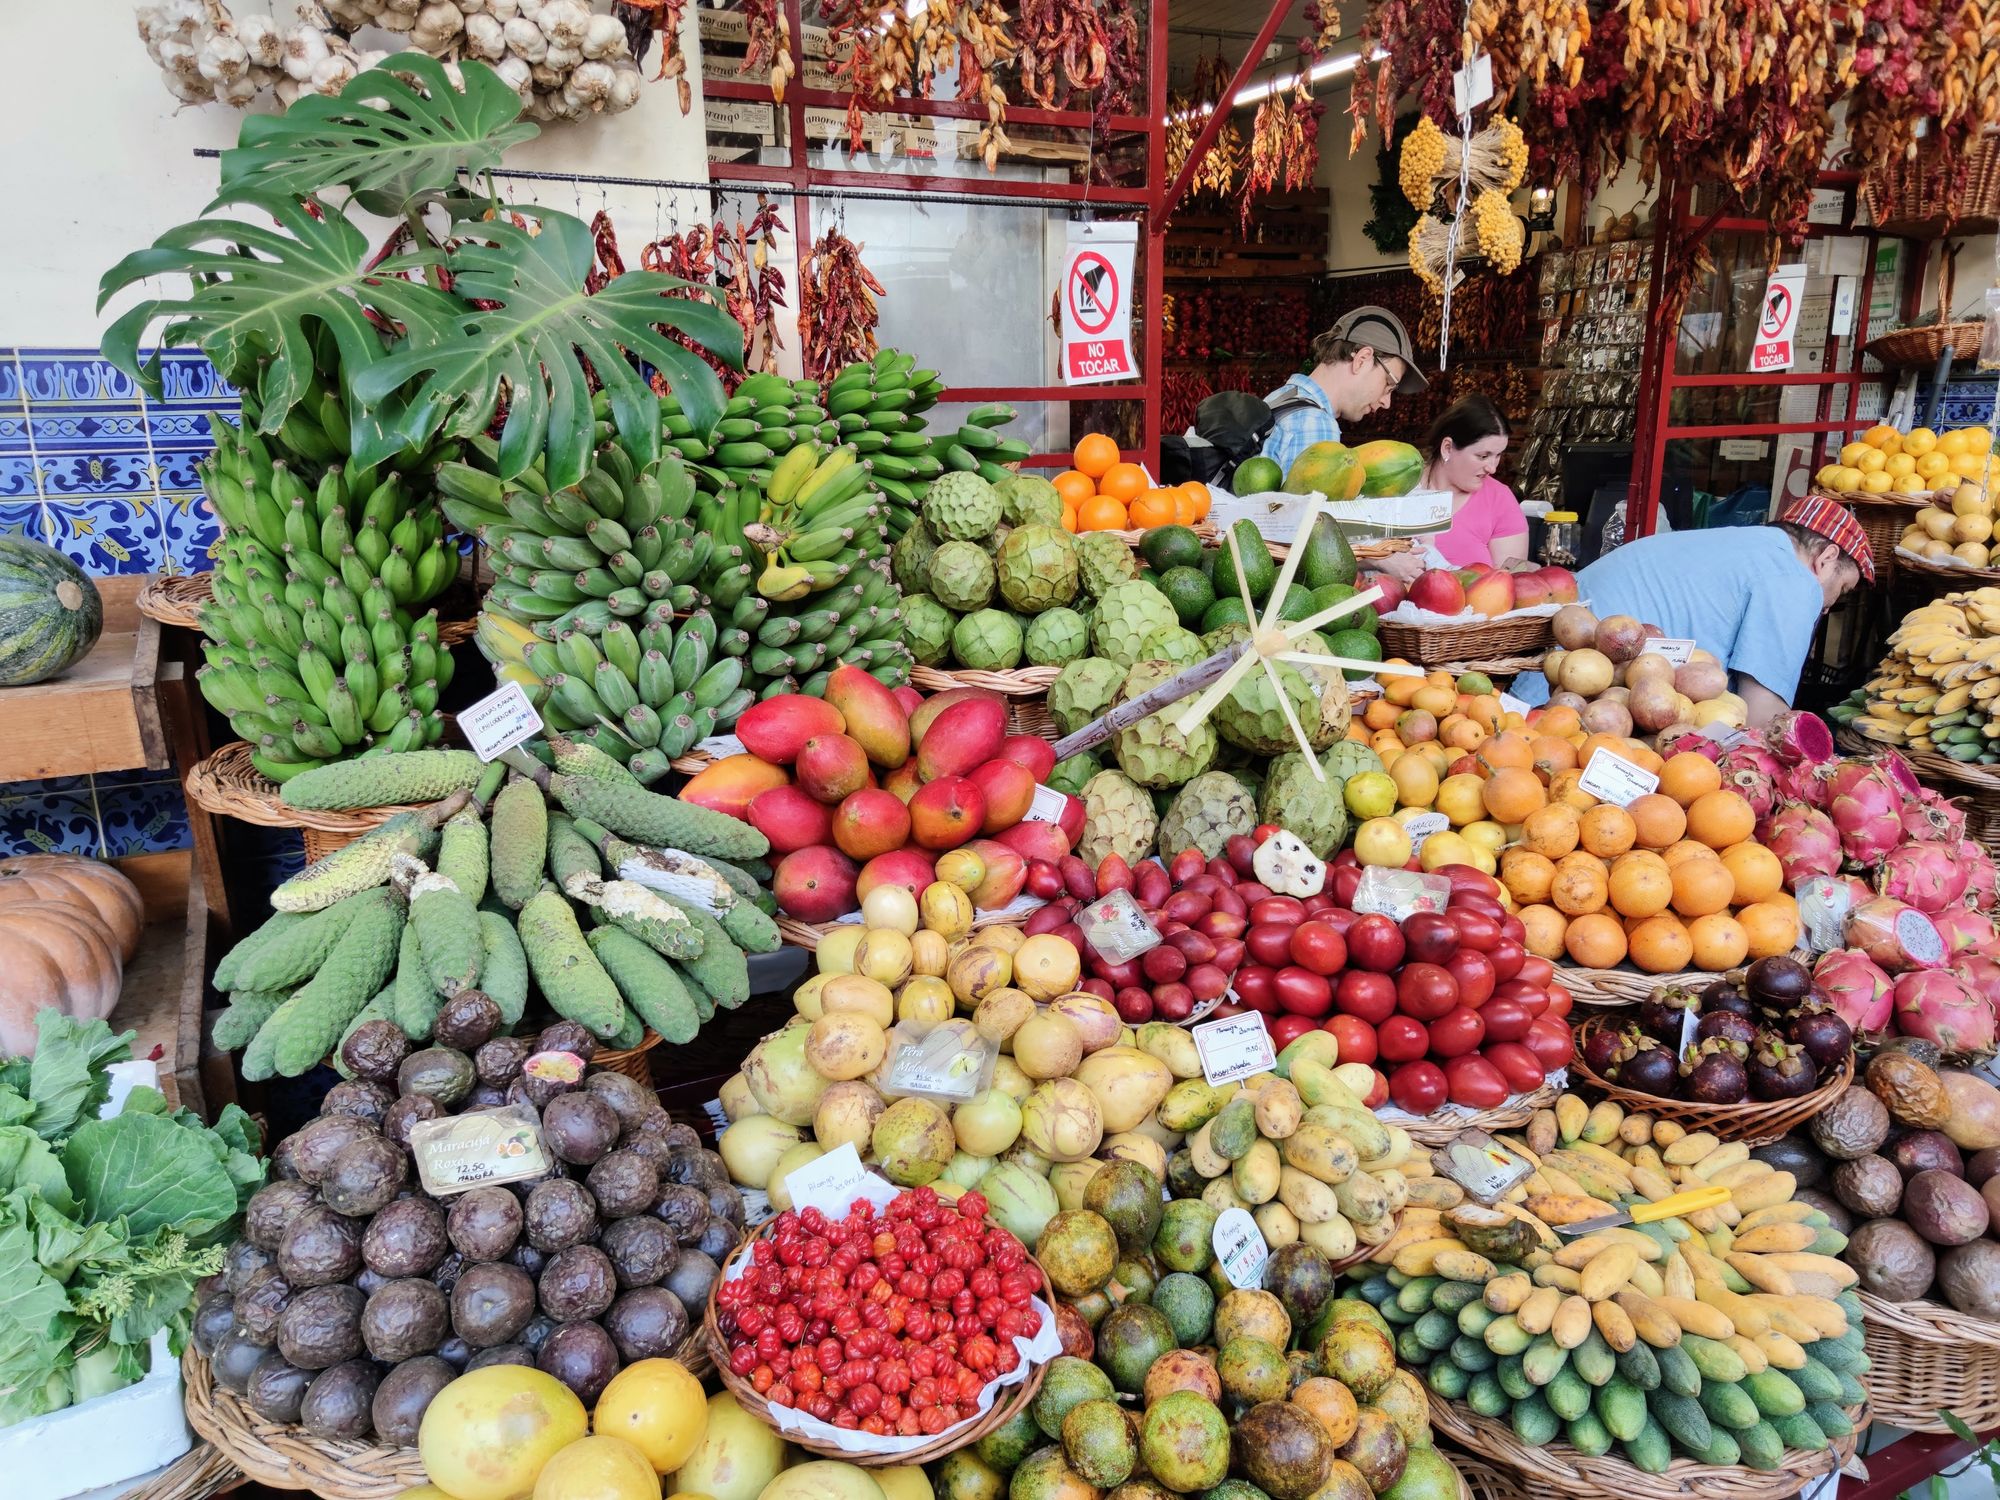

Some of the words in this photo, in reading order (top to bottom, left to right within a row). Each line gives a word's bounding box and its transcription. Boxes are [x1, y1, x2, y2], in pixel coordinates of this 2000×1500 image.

[699, 16, 742, 32] morango
[1088, 343, 1105, 358] NO
[1766, 344, 1777, 354] NO
[1079, 359, 1120, 376] TOCAR
[1759, 353, 1785, 367] TOCAR
[428, 1135, 490, 1155] Maracujá
